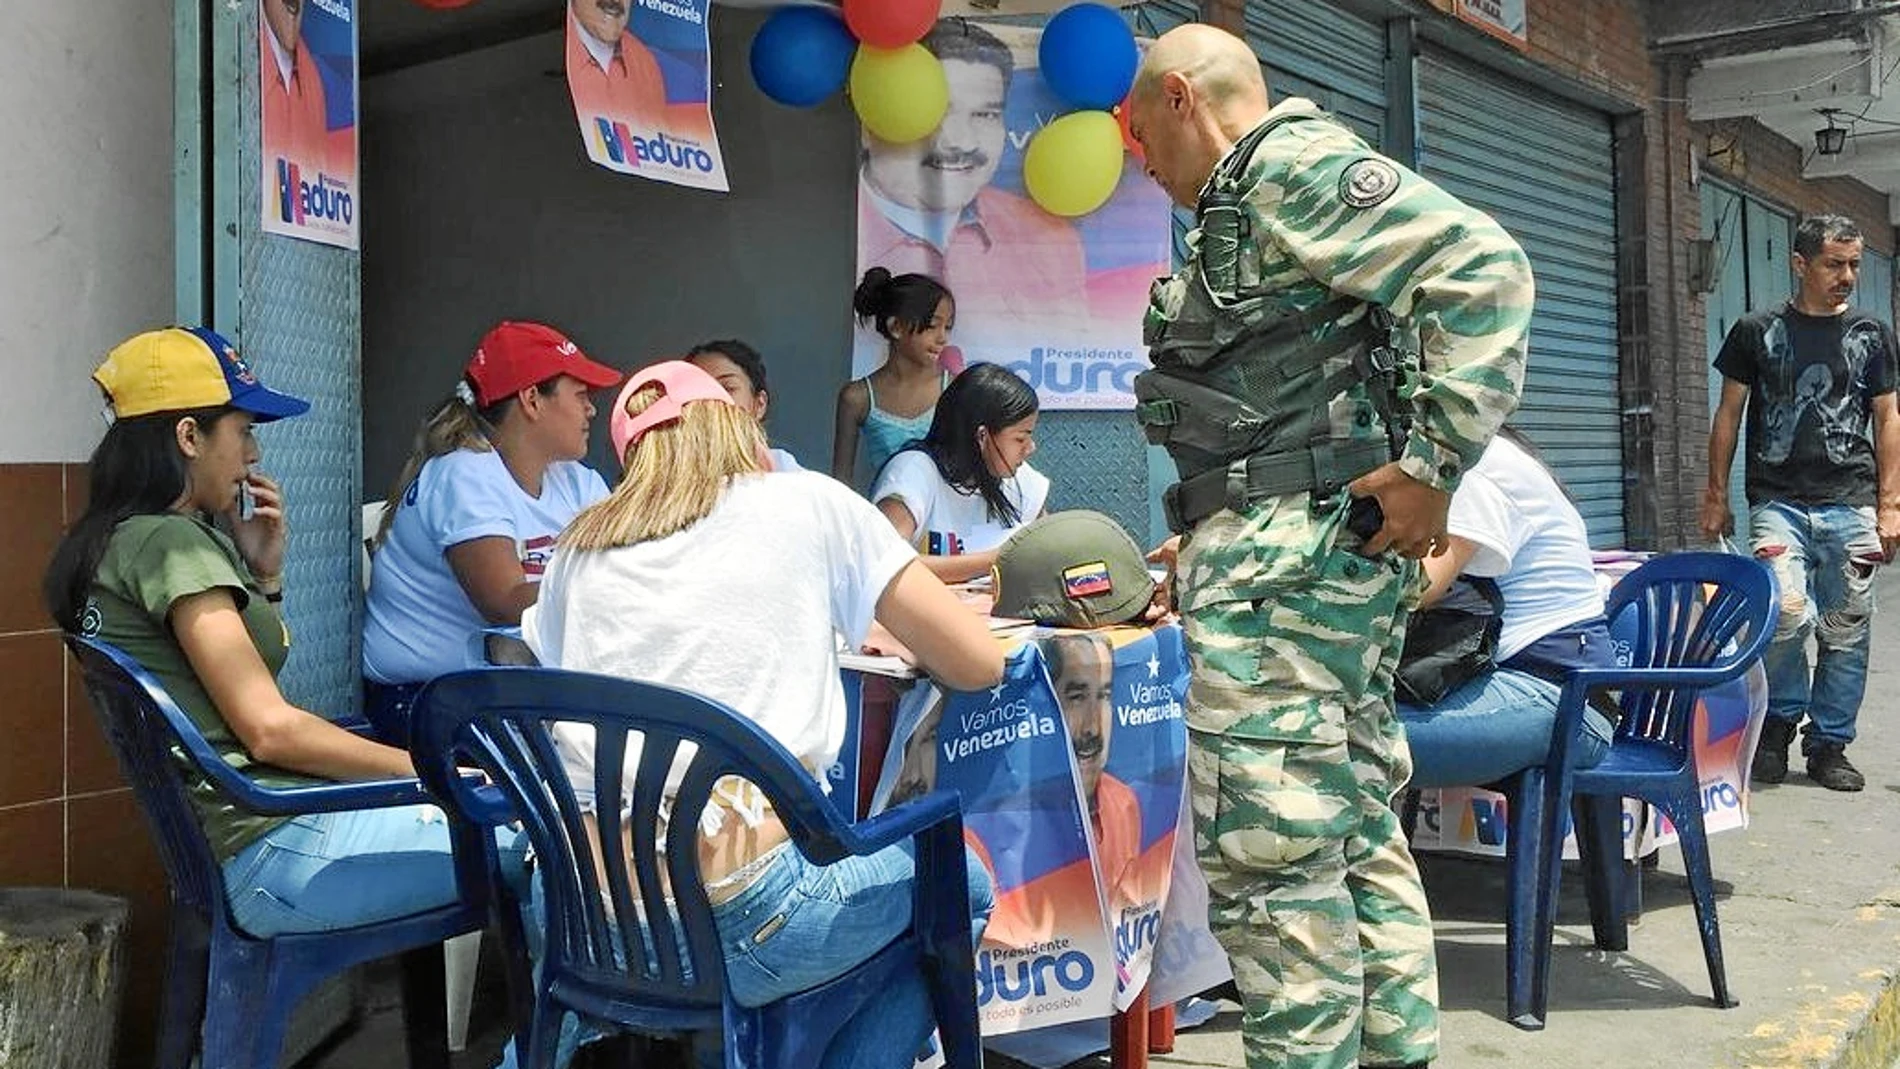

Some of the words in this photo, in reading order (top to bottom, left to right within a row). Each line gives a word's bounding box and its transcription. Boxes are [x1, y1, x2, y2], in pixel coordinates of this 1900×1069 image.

[1045, 347, 1134, 360] Presidente
[1005, 347, 1150, 394] duro
[1129, 681, 1172, 704] Vamos
[961, 698, 1029, 733] Vamos
[1117, 696, 1181, 727] Venezuela
[943, 713, 1056, 763] Venezuela
[993, 938, 1070, 961] Presidente
[976, 950, 1095, 1007] duro
[986, 1005, 1017, 1021] todo
[1036, 996, 1082, 1015] posible
